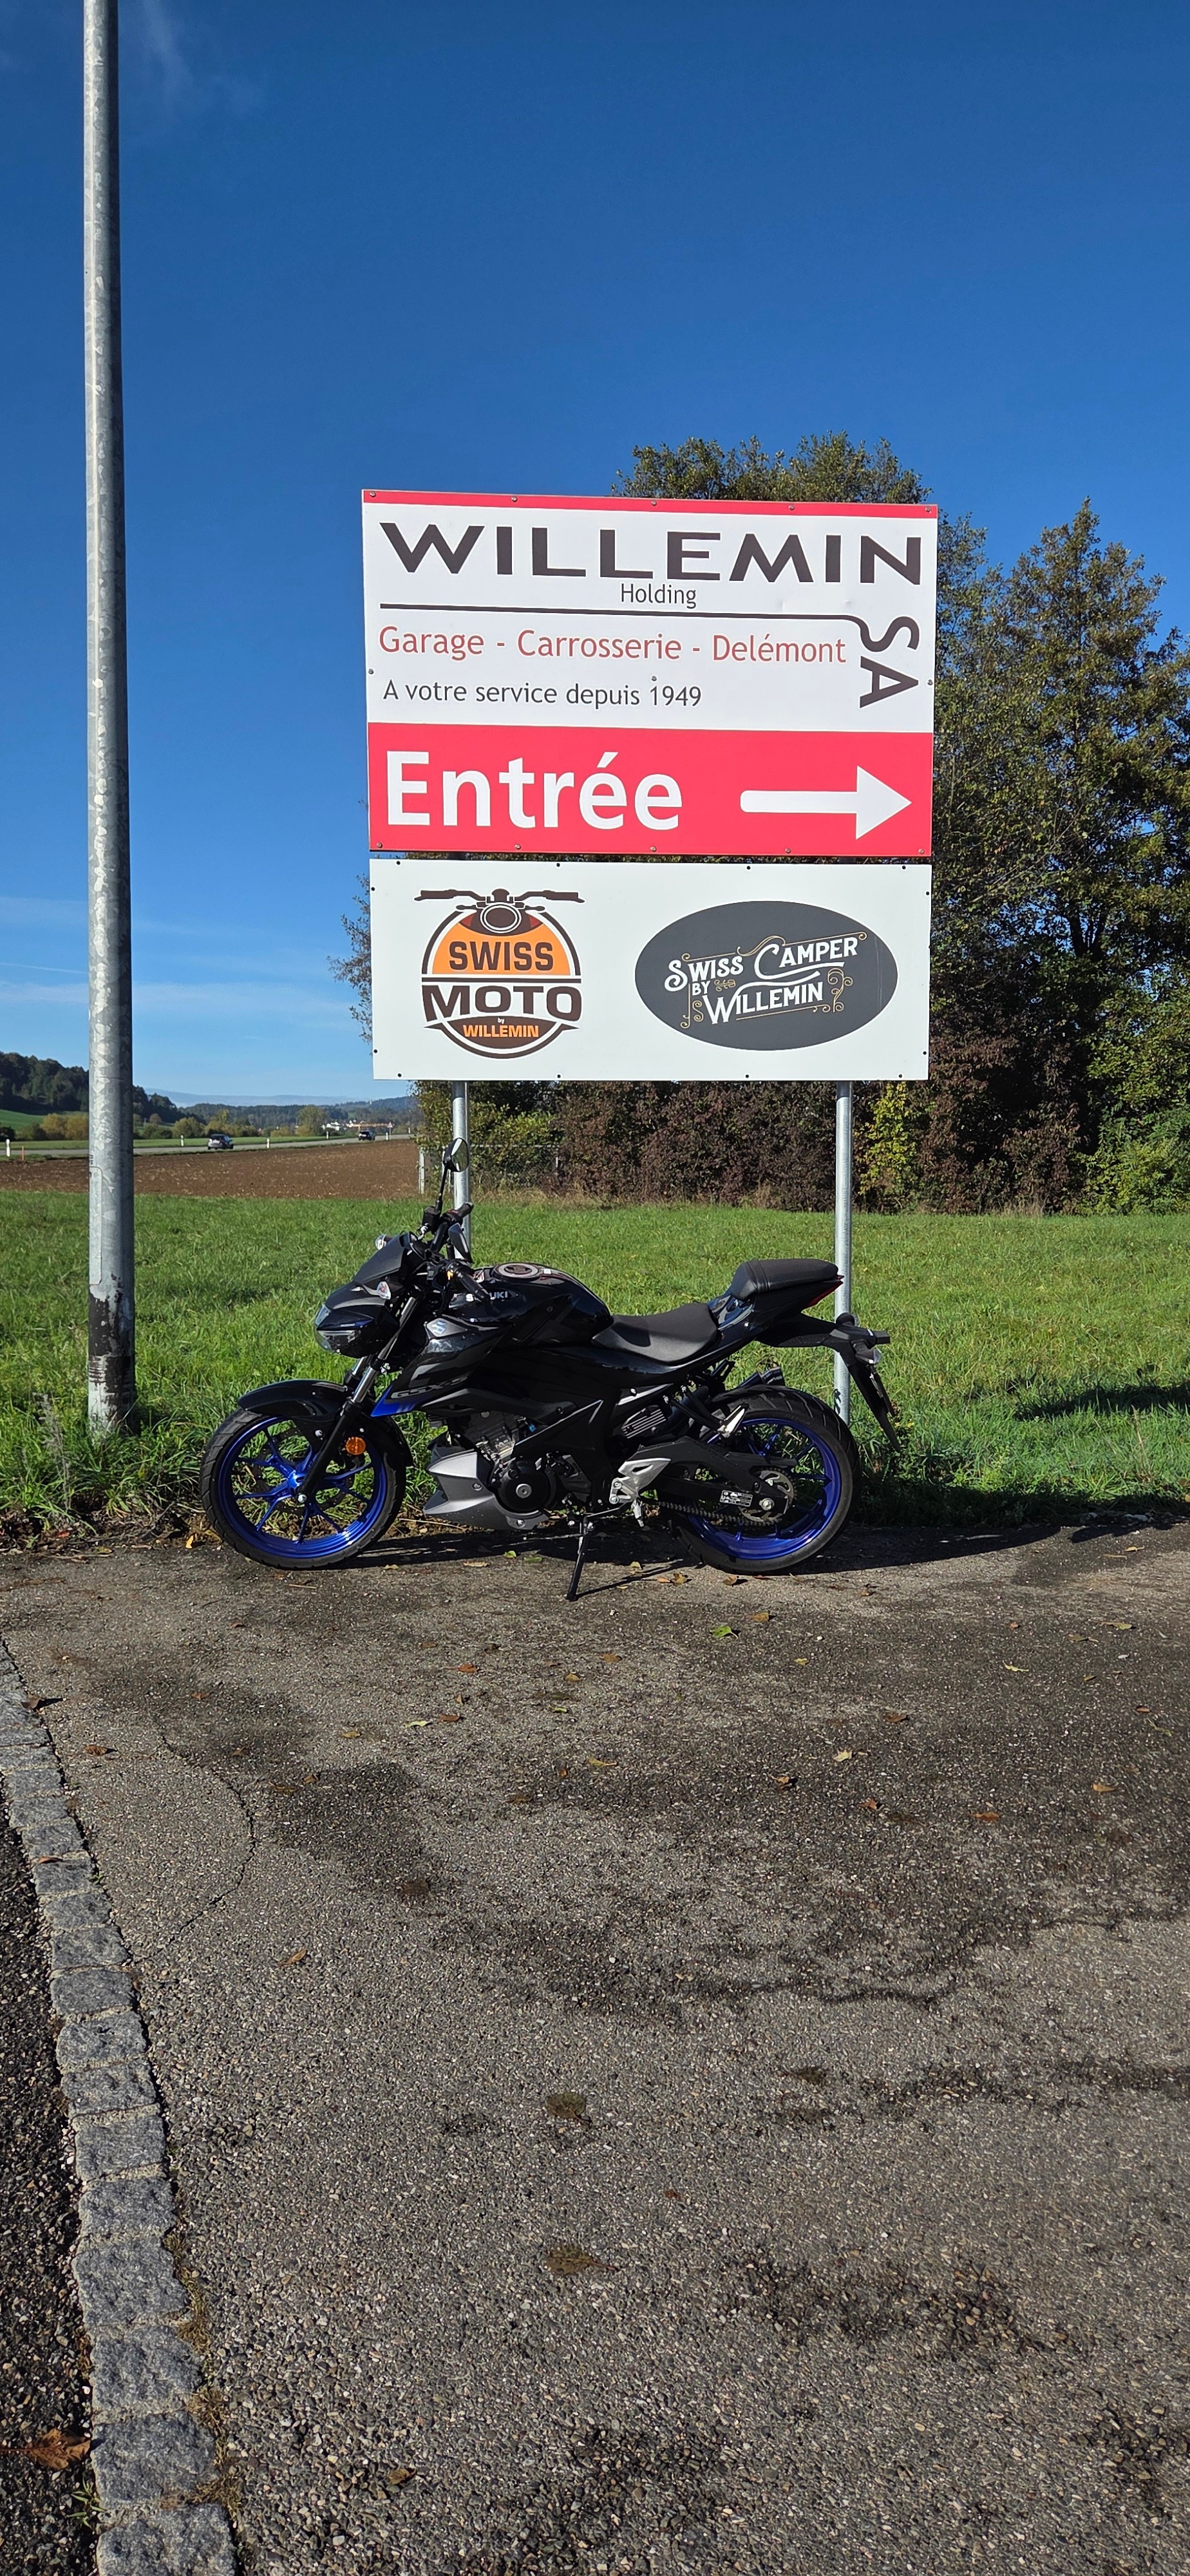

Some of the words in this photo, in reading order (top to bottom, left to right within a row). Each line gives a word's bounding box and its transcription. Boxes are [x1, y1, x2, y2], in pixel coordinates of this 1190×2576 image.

[379, 522, 921, 585] WILLEMIN
[621, 583, 697, 609] Holding
[379, 626, 484, 661] Garage
[518, 629, 682, 660] Carrosserie
[713, 633, 847, 663] Delémont
[859, 616, 920, 708] SA
[382, 679, 399, 700] A
[404, 682, 467, 701] votre
[476, 682, 558, 703] service
[566, 683, 640, 710] depuis
[650, 685, 702, 706] 1949
[386, 750, 683, 831] Entrée
[449, 941, 554, 971] SWISS
[421, 984, 582, 1022] MOTO
[462, 1024, 540, 1037] WILLEMIN
[465, 1291, 508, 1302] SUKI
